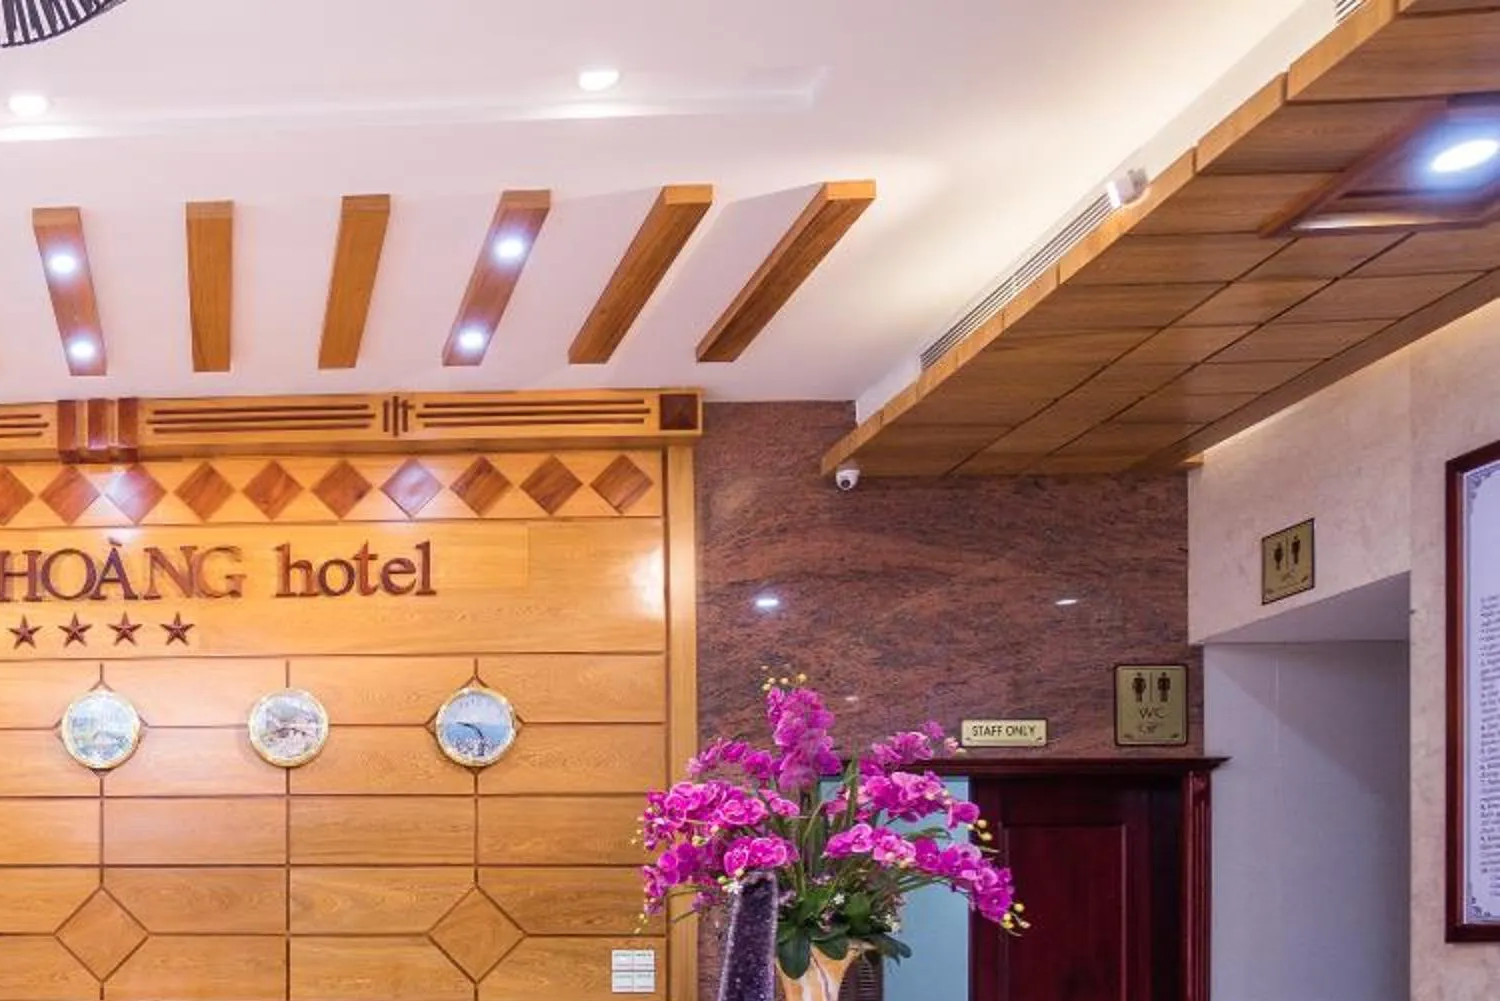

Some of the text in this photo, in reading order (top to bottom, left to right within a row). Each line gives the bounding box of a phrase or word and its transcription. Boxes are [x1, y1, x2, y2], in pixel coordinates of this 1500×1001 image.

[273, 540, 438, 598] hotel
[971, 725, 1037, 737] STAFF ONLY
